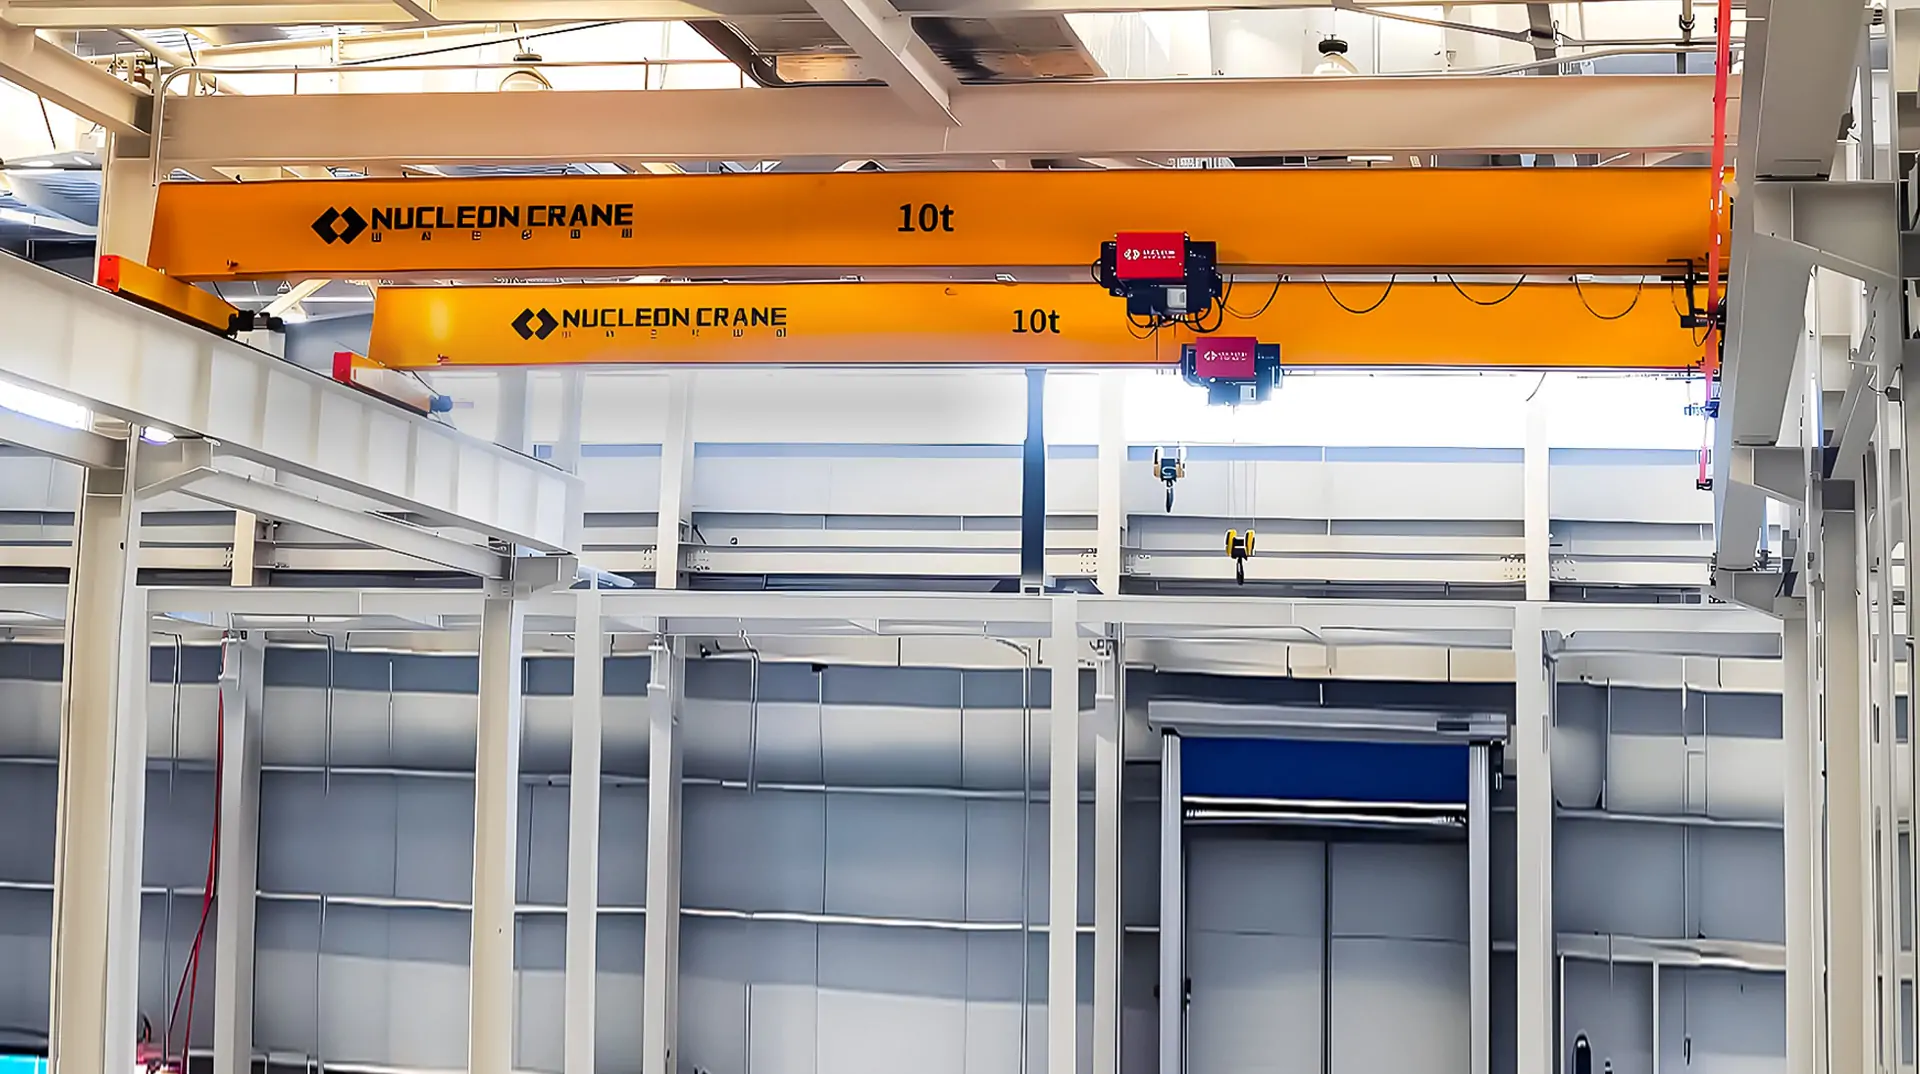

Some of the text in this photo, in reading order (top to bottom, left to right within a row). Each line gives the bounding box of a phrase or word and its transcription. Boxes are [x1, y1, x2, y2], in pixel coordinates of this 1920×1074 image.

[371, 203, 634, 230] NUCLEON CRANE
[897, 203, 955, 232] 10t
[562, 307, 787, 328] NUCLEON CRANE
[1012, 309, 1061, 334] 10t
